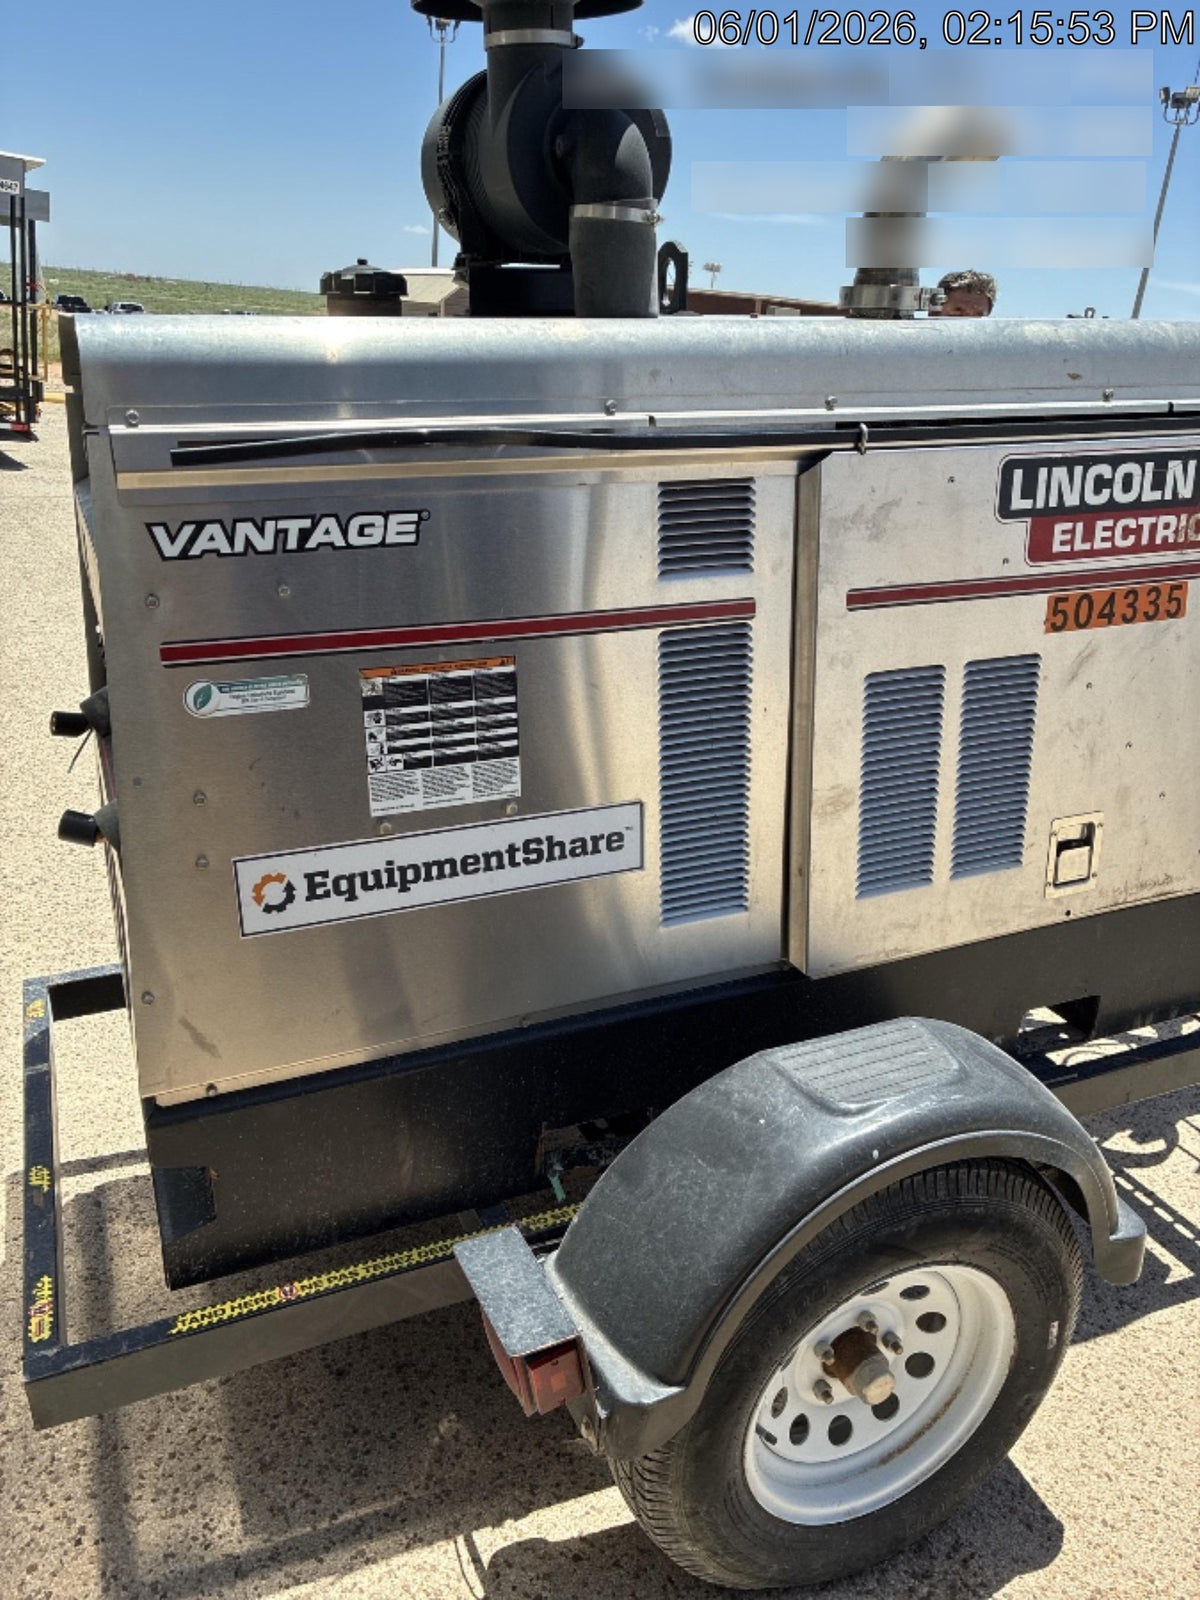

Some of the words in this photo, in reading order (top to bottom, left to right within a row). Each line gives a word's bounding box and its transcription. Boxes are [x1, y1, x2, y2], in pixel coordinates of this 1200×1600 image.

[1010, 459, 1198, 511] LINCOLN
[1050, 584, 1183, 632] 504335
[179, 1306, 227, 1327] TAND
[230, 1292, 278, 1314] HERE
